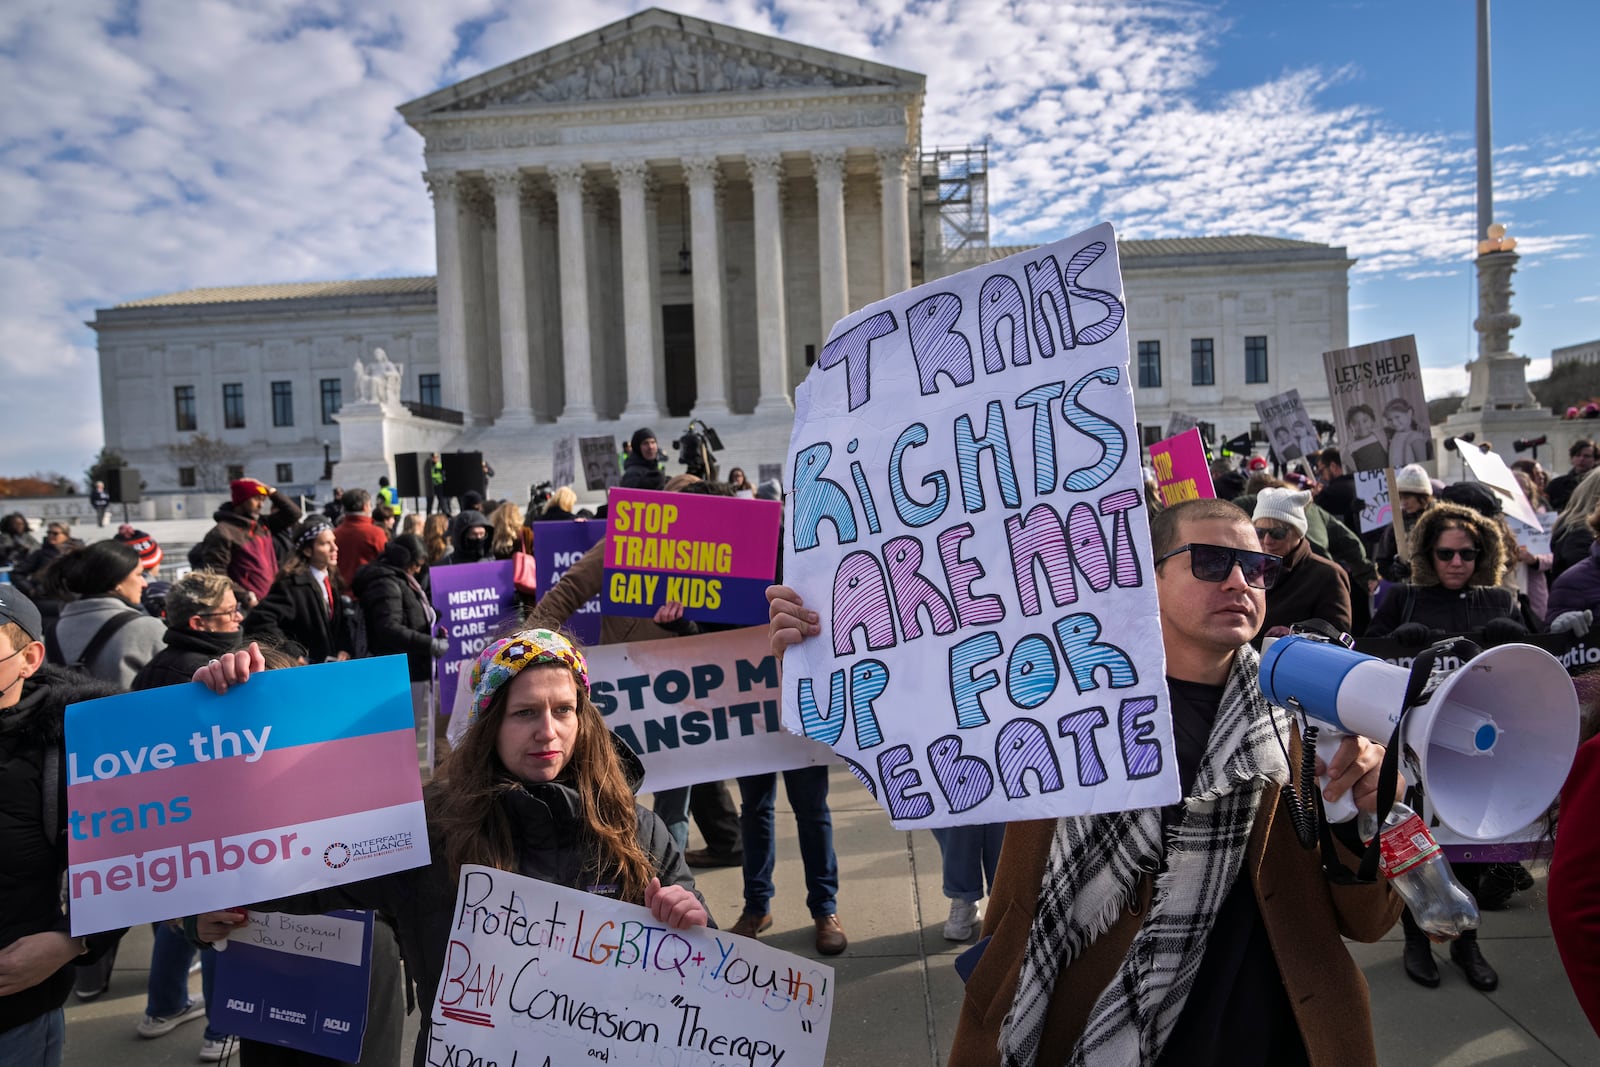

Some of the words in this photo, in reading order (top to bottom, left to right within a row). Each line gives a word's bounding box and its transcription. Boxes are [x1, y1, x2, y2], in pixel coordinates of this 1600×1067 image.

[818, 241, 1125, 412] TRANS
[1334, 362, 1373, 384] LET'S
[1375, 354, 1411, 376] HELP
[1334, 374, 1361, 395] not
[1368, 369, 1418, 388] harm
[1153, 451, 1173, 482] STOP
[615, 500, 678, 535] STOP
[613, 535, 733, 573] TRANSING
[832, 522, 1006, 657] ARE
[1004, 489, 1143, 617] NOT
[448, 587, 499, 605] MENTAL
[609, 573, 660, 605] GAY
[666, 576, 722, 610] KIDS
[451, 603, 499, 621] HEALTH
[452, 622, 486, 638] CARE
[590, 664, 724, 716] STOP
[798, 659, 889, 750] UP
[948, 612, 1139, 729] FOR
[69, 743, 176, 786] Love
[189, 725, 272, 762] thy
[69, 795, 192, 841] trans
[352, 832, 411, 849] INTERFAITH
[353, 838, 412, 857] ALLIANCE
[73, 831, 312, 899] neighbor.
[280, 915, 341, 940] Bisexual
[457, 871, 566, 949] Protect
[572, 909, 706, 979] LGBTQ+
[253, 929, 285, 947] Jew
[294, 936, 323, 952] Girl
[226, 998, 255, 1013] ACLU
[439, 940, 505, 1008] BAN
[509, 958, 660, 1044] Conversion
[276, 1008, 307, 1019] LAMBDA
[280, 1015, 306, 1025] LEGAL
[323, 1018, 350, 1032] ACLU
[587, 1047, 609, 1063] and
